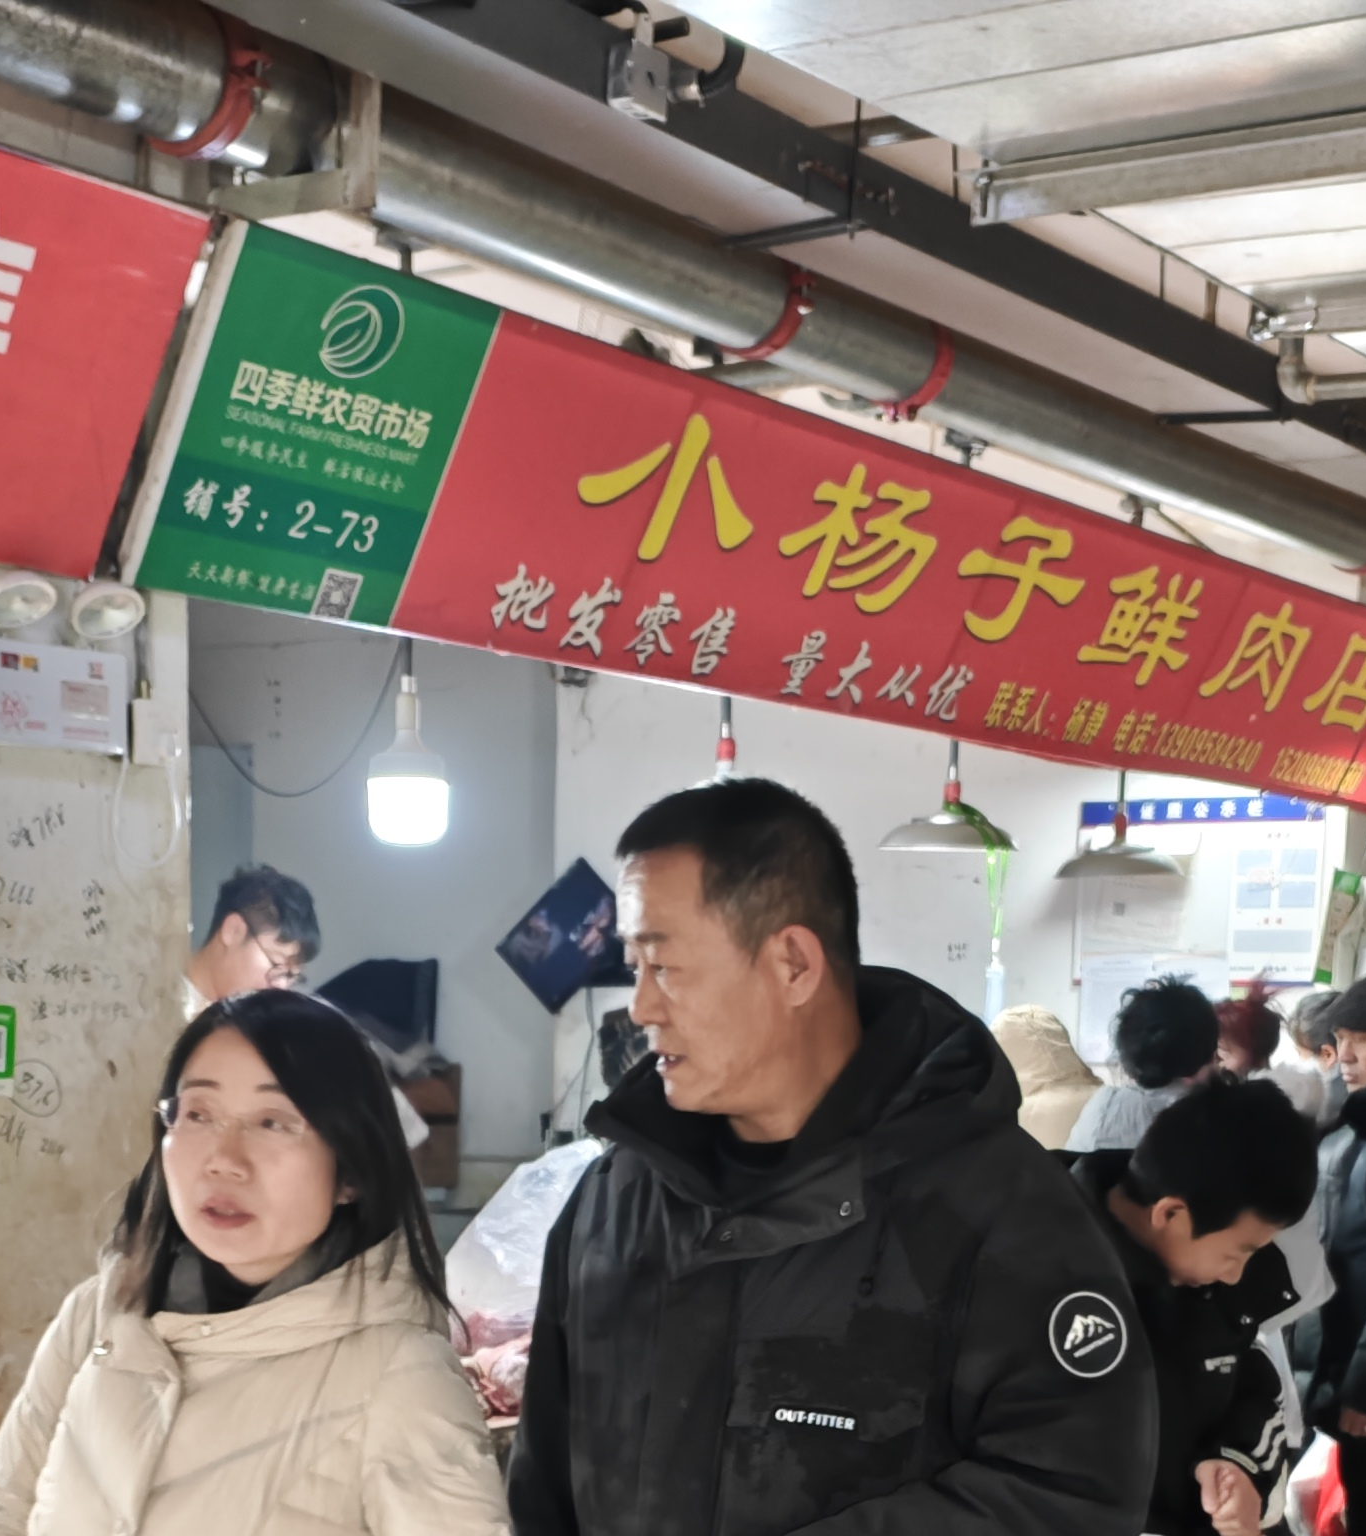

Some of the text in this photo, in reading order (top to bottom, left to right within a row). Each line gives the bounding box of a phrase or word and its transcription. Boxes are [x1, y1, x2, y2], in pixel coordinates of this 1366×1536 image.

[230, 359, 432, 449] 四季鲜农贸市场
[490, 564, 975, 721] 批发零售 量大从优
[774, 1408, 856, 1430] OUT-FITTER
